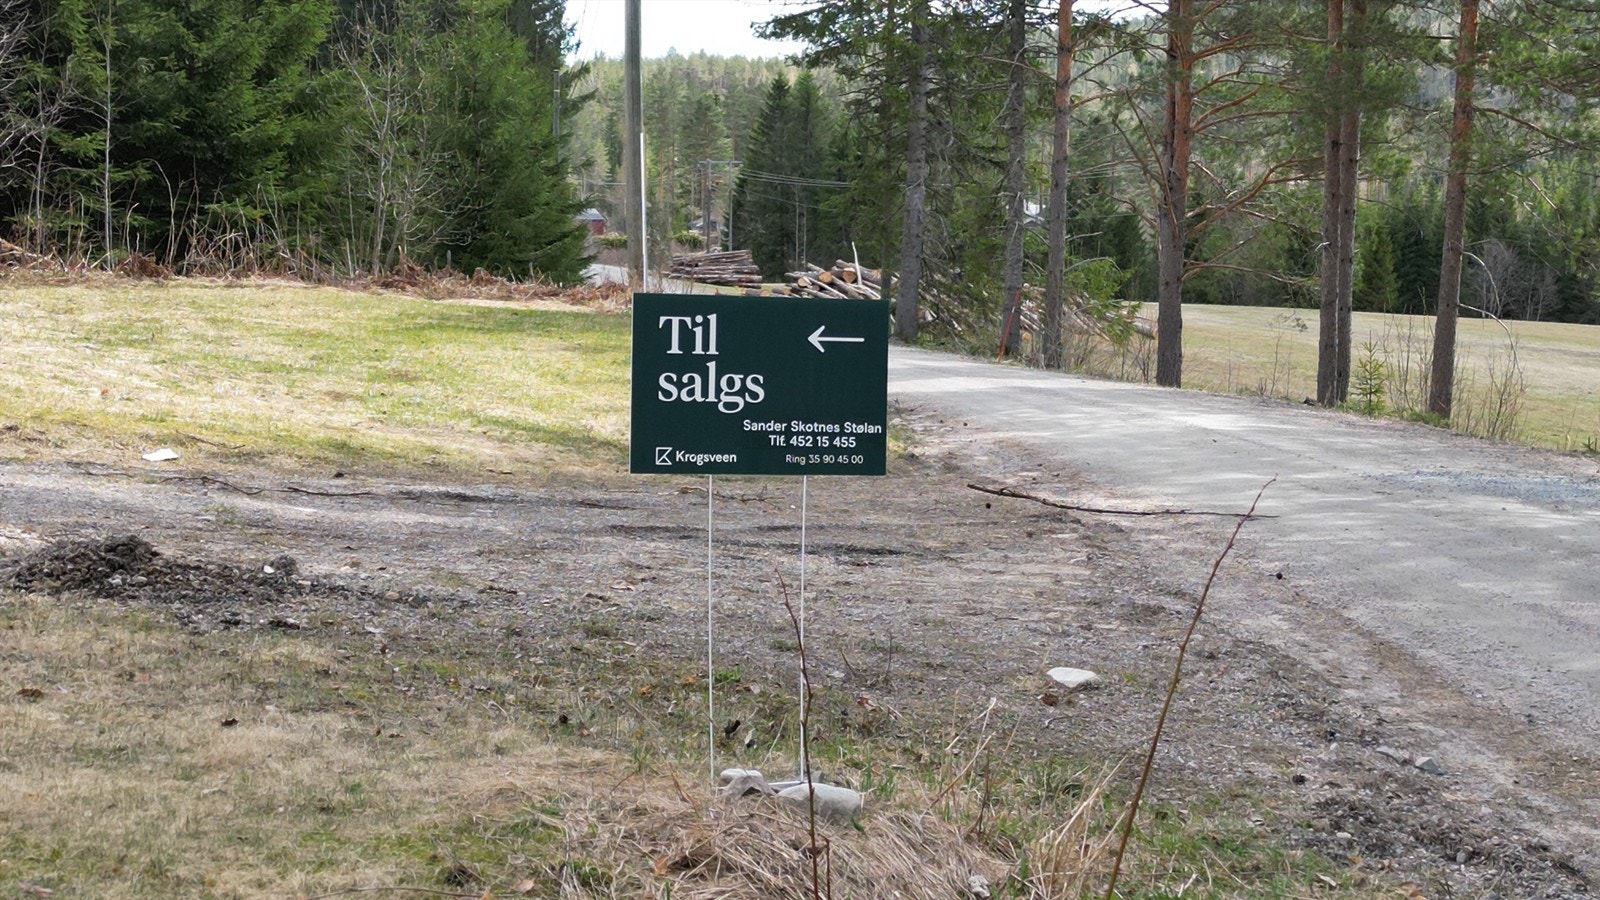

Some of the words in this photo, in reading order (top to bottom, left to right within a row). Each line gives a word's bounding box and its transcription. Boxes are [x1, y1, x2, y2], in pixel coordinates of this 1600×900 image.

[659, 313, 719, 355] Til
[658, 361, 765, 413] salgs
[743, 419, 787, 432] Sander
[791, 420, 840, 433] Skotnes
[844, 421, 882, 434] Stølan
[769, 434, 785, 447] Tlf.
[790, 435, 813, 447] 452
[816, 435, 830, 447] 15
[833, 436, 857, 448] 455
[675, 450, 737, 466] Krogsveen
[785, 454, 806, 465] Ring
[809, 454, 820, 464] 35
[822, 454, 835, 464] 90
[837, 454, 849, 464] 45
[851, 455, 864, 464] 00
